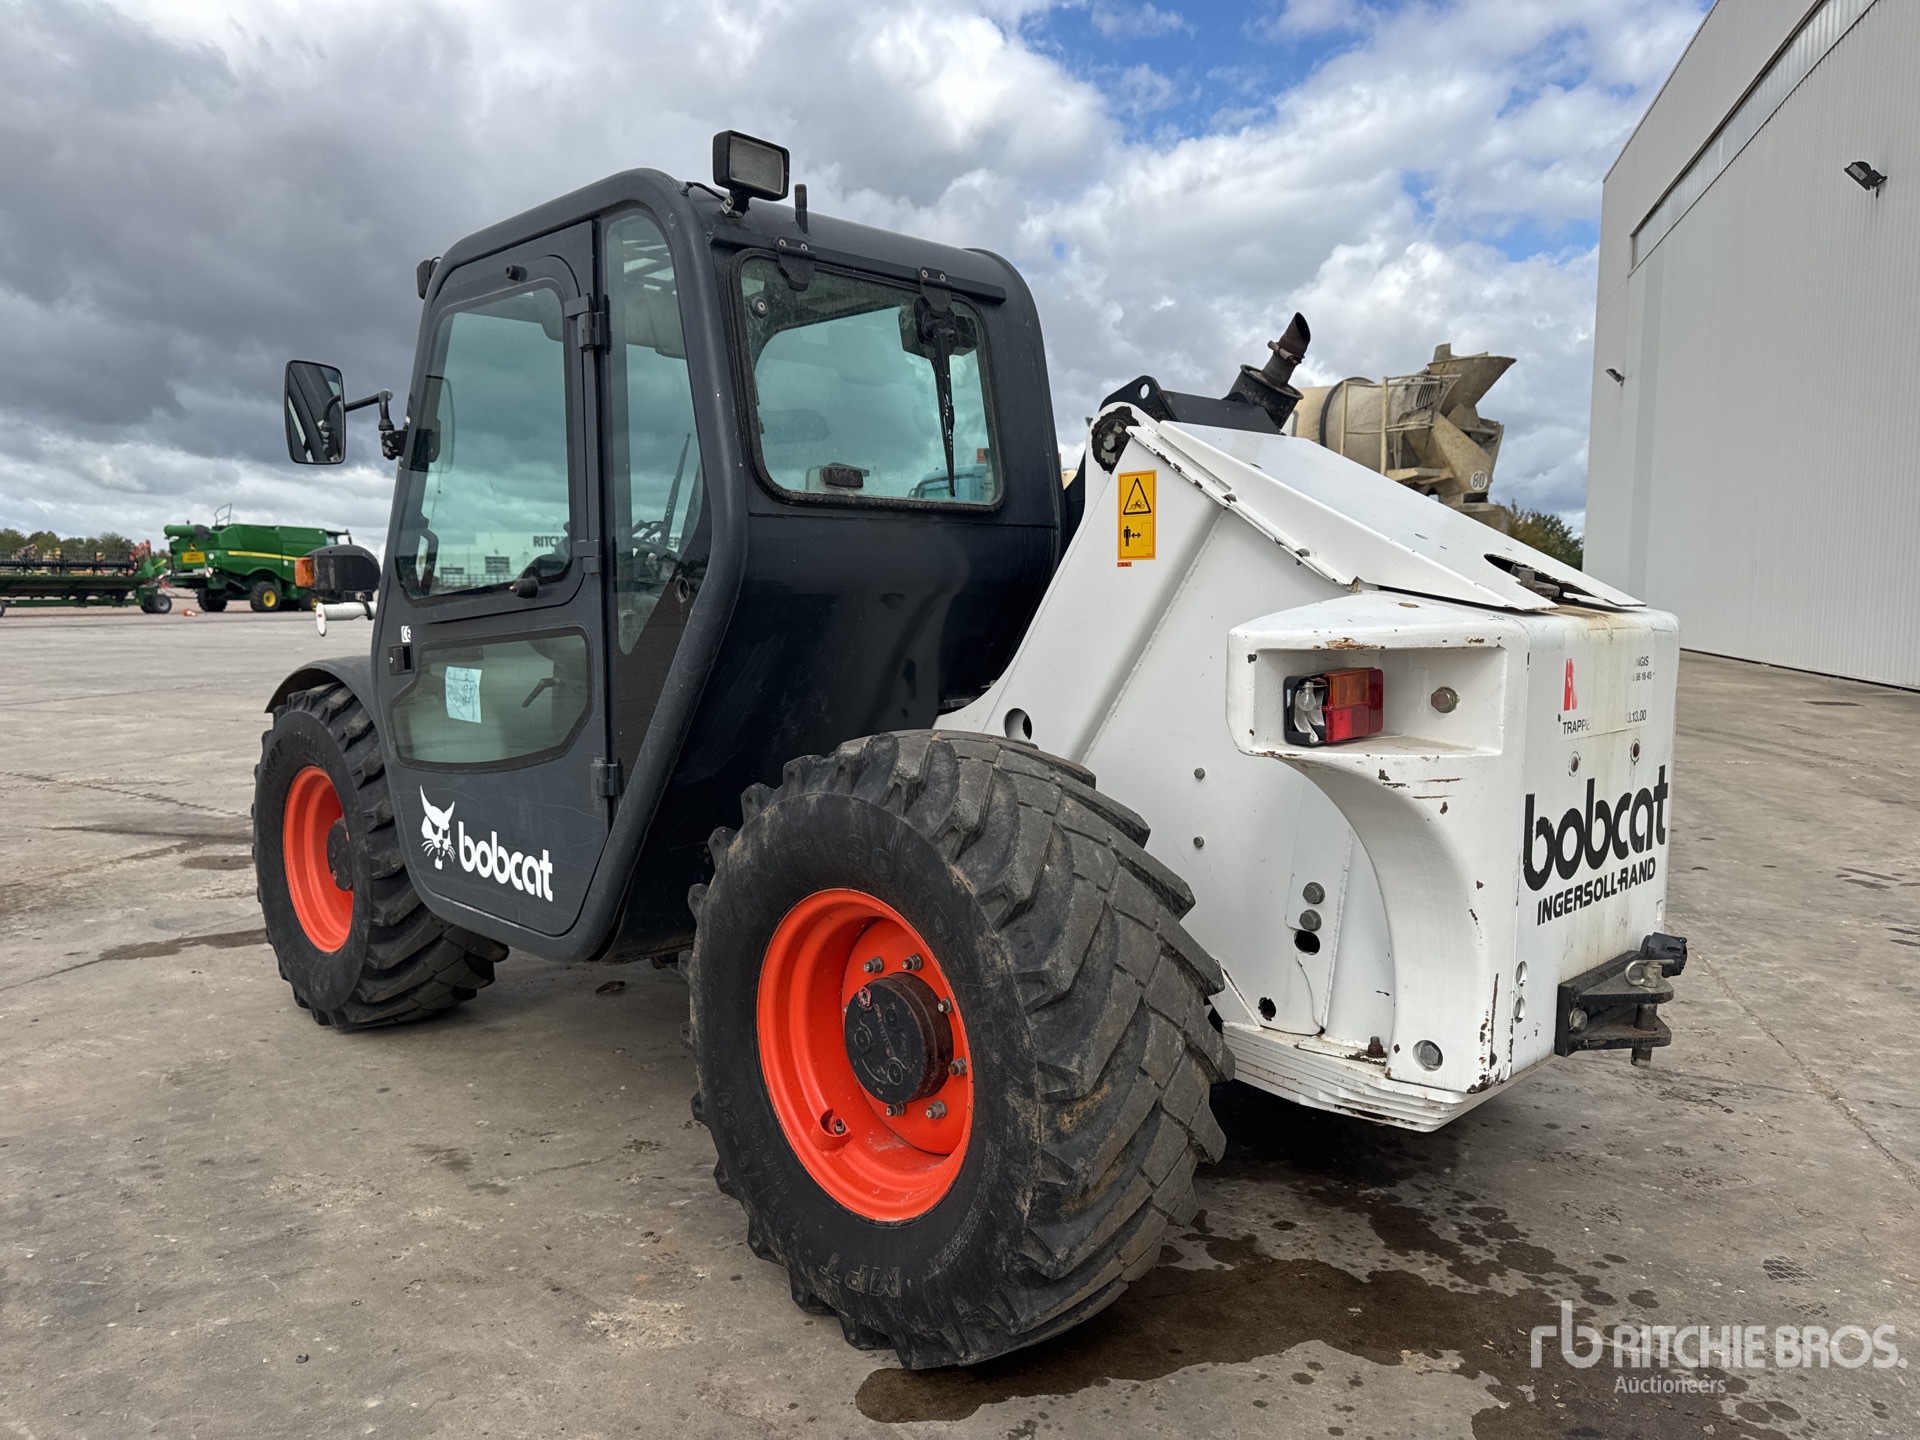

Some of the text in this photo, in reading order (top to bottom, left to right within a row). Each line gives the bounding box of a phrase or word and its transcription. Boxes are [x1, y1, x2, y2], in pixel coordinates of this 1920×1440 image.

[1472, 472, 1485, 489] 80
[533, 535, 563, 548] RITC
[1523, 764, 1669, 892] bobcat
[458, 820, 553, 902] bobcat
[818, 1251, 902, 1298] MPT
